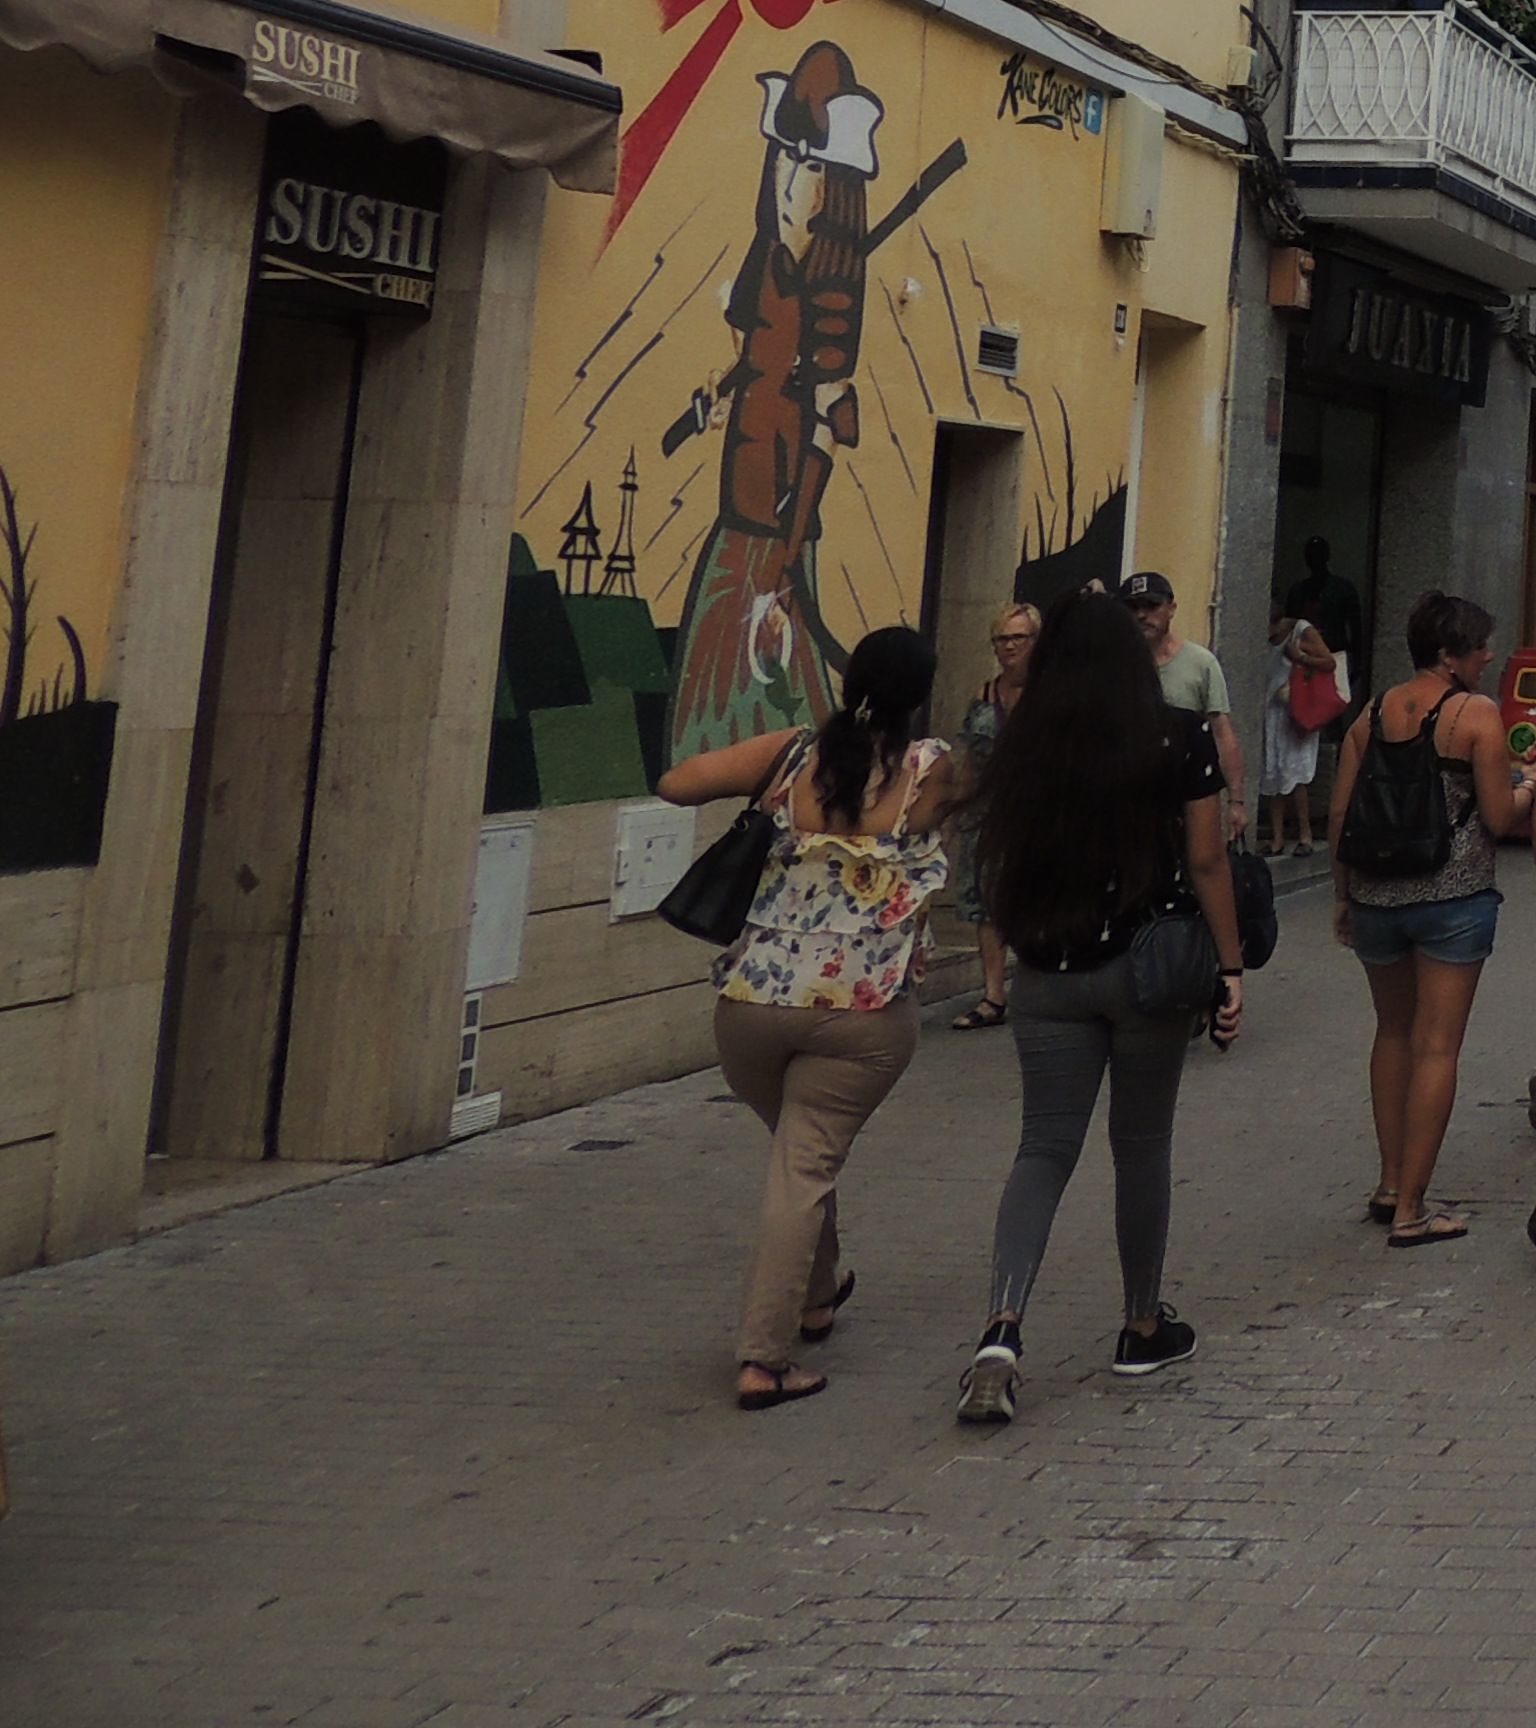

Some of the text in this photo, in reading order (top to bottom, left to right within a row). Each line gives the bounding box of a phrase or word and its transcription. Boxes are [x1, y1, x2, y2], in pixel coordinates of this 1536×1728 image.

[252, 20, 361, 89] SUSHI
[324, 83, 360, 105] CHEF
[264, 177, 441, 273] SUSHI
